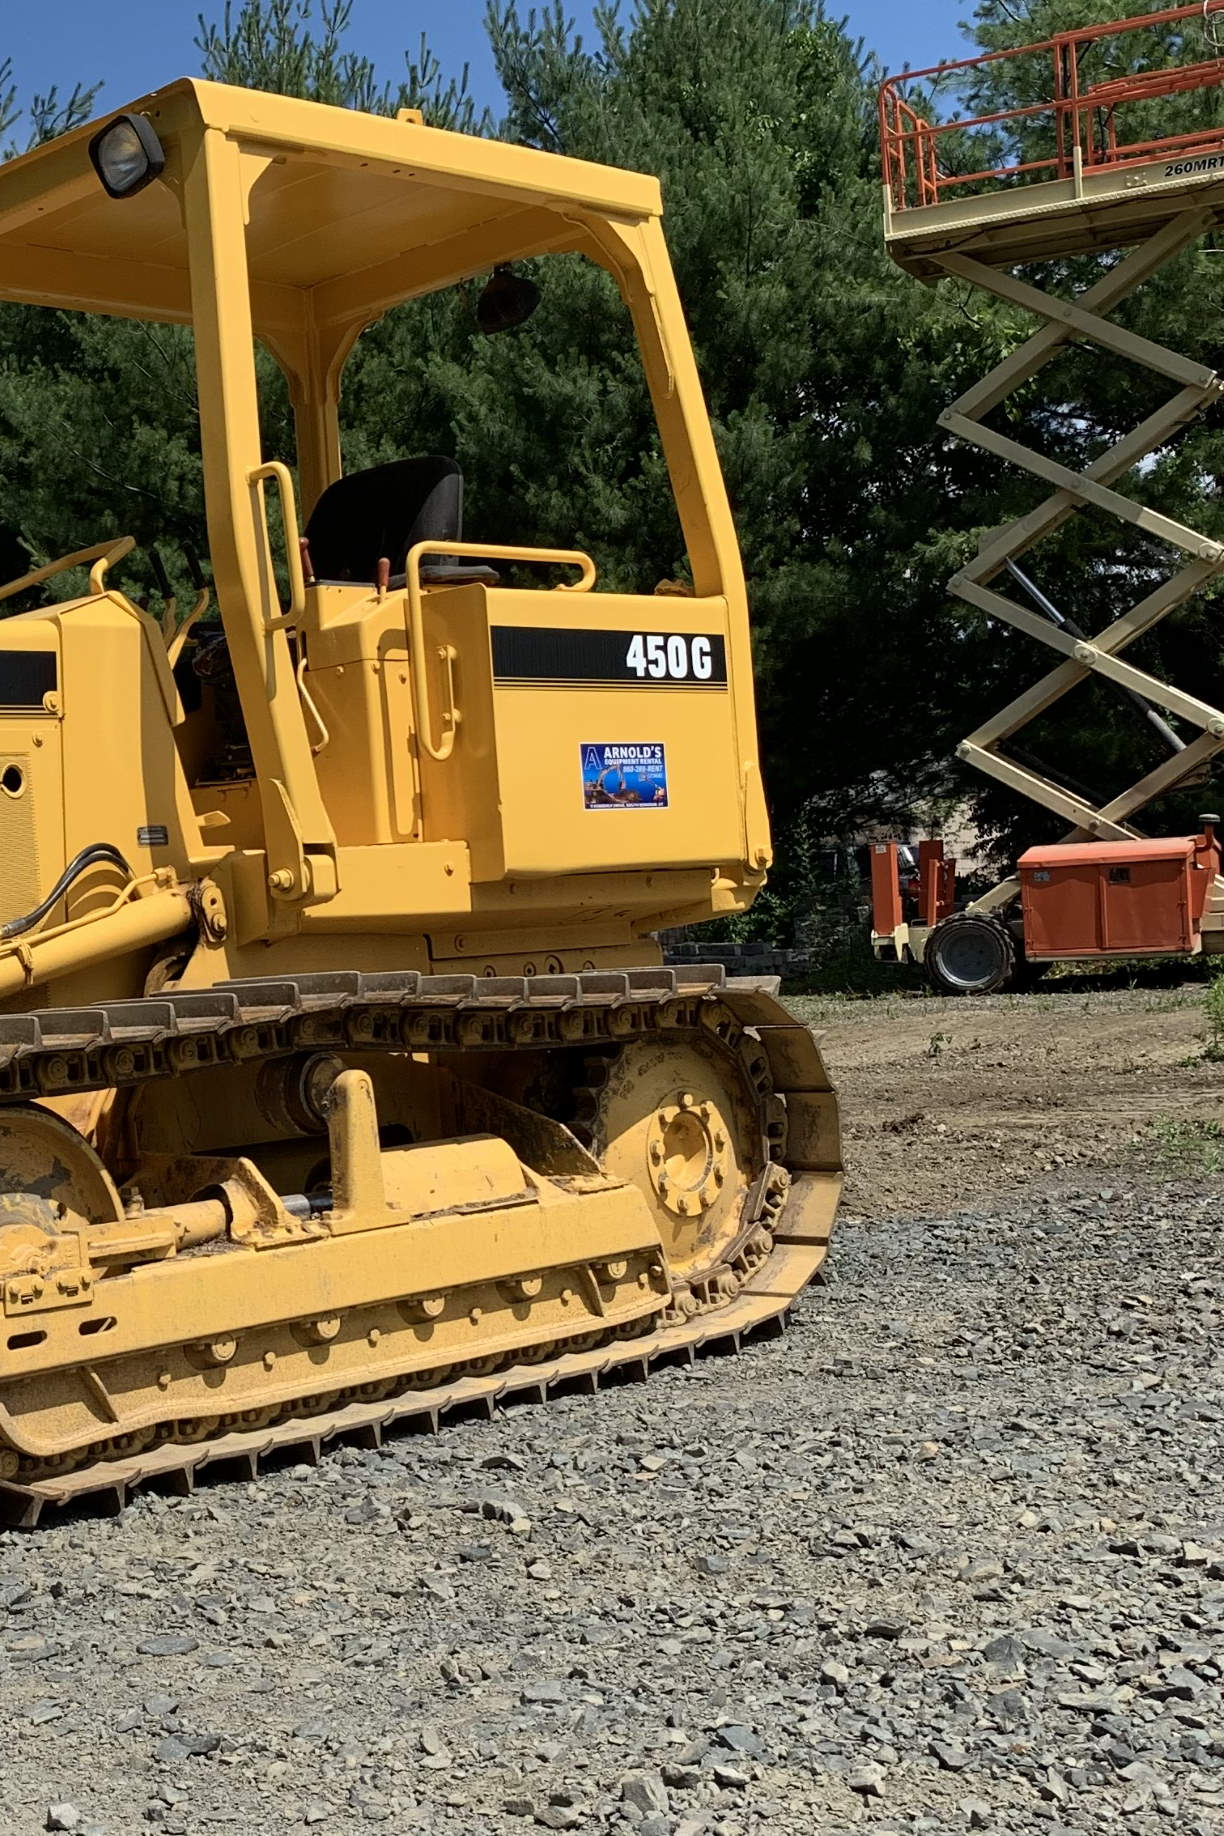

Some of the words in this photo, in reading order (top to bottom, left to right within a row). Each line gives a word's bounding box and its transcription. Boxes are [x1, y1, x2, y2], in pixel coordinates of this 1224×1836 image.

[626, 635, 712, 679] 450G
[585, 747, 602, 770] A
[604, 746, 662, 758] ARNOLD'S
